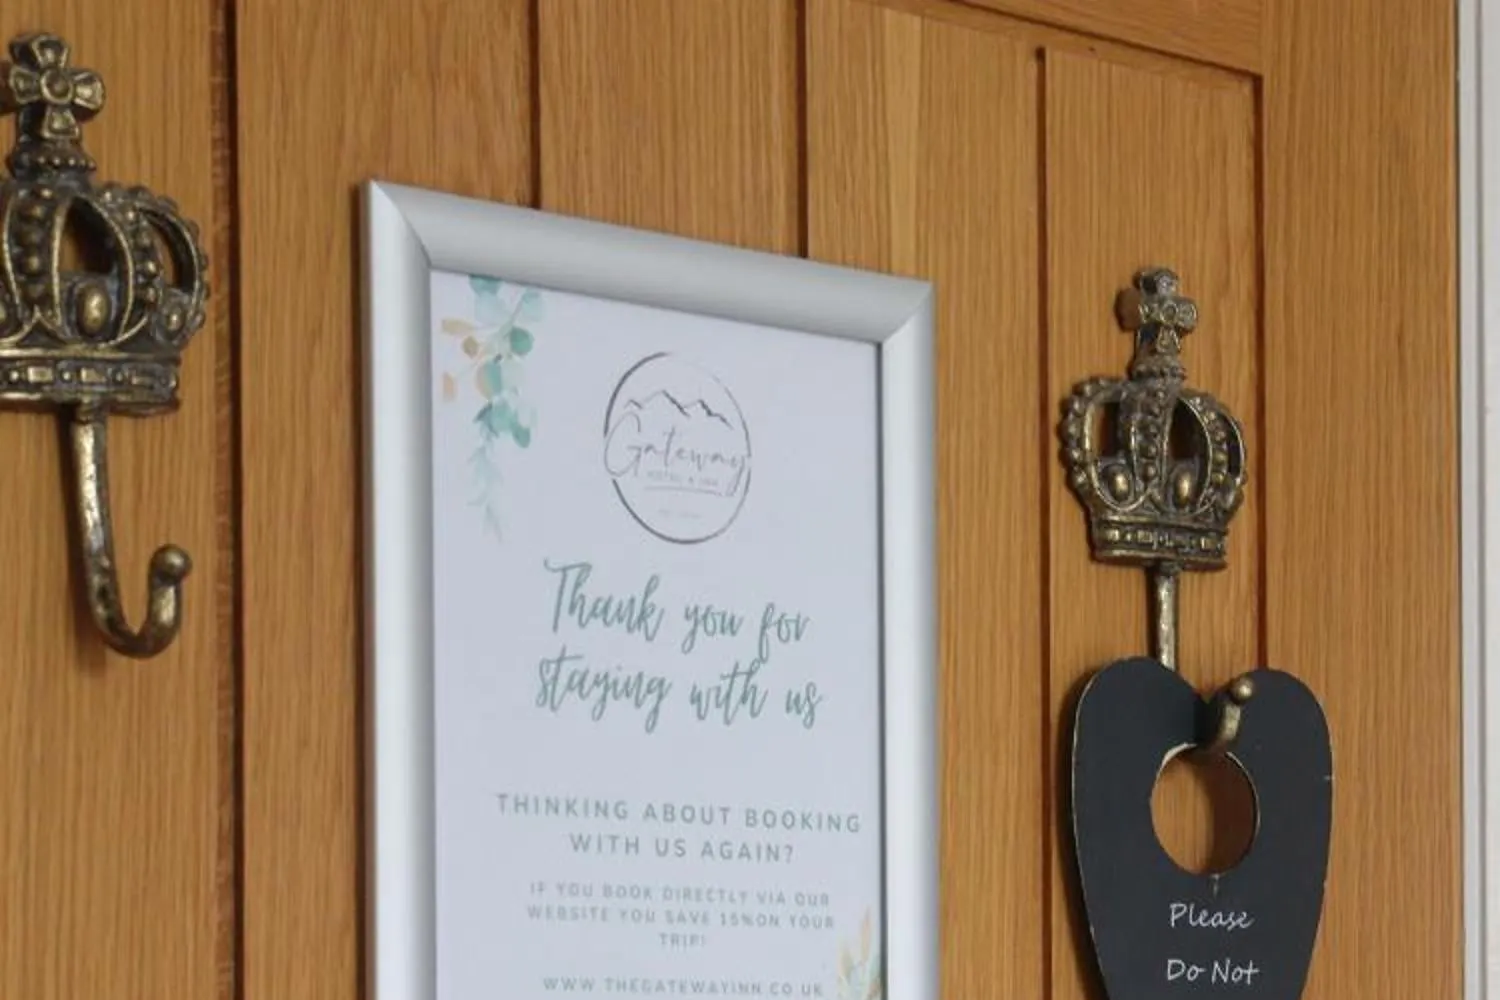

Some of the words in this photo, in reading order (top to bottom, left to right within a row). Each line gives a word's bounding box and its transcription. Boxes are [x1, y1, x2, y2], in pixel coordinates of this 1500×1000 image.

[544, 557, 664, 641] Thank
[681, 603, 743, 654] you
[757, 602, 810, 663] for
[535, 645, 672, 733] staying
[690, 659, 768, 725] with
[785, 682, 823, 729] us
[496, 794, 629, 820] THINKING
[643, 803, 732, 826] ABOUT
[744, 808, 862, 833] BOOKING
[570, 833, 641, 855] WITH
[655, 838, 688, 858] US
[700, 841, 795, 864] AGAIN?
[530, 881, 546, 895] IF
[556, 882, 594, 898] YOU
[602, 883, 653, 900] BOOK
[662, 886, 748, 905] DIRECTLY
[756, 891, 786, 905] VIA
[794, 891, 830, 907] OUR
[527, 905, 609, 922] WEBSITE
[619, 908, 656, 924] YOU
[665, 910, 711, 926] SAVE
[789, 914, 834, 930] YOUR
[1169, 902, 1256, 931] Please
[659, 932, 706, 949] TRIP!
[1166, 958, 1207, 982] Do
[1210, 957, 1260, 985] Not
[542, 976, 825, 997] WWWTHEGATEWAYINNCOUK
